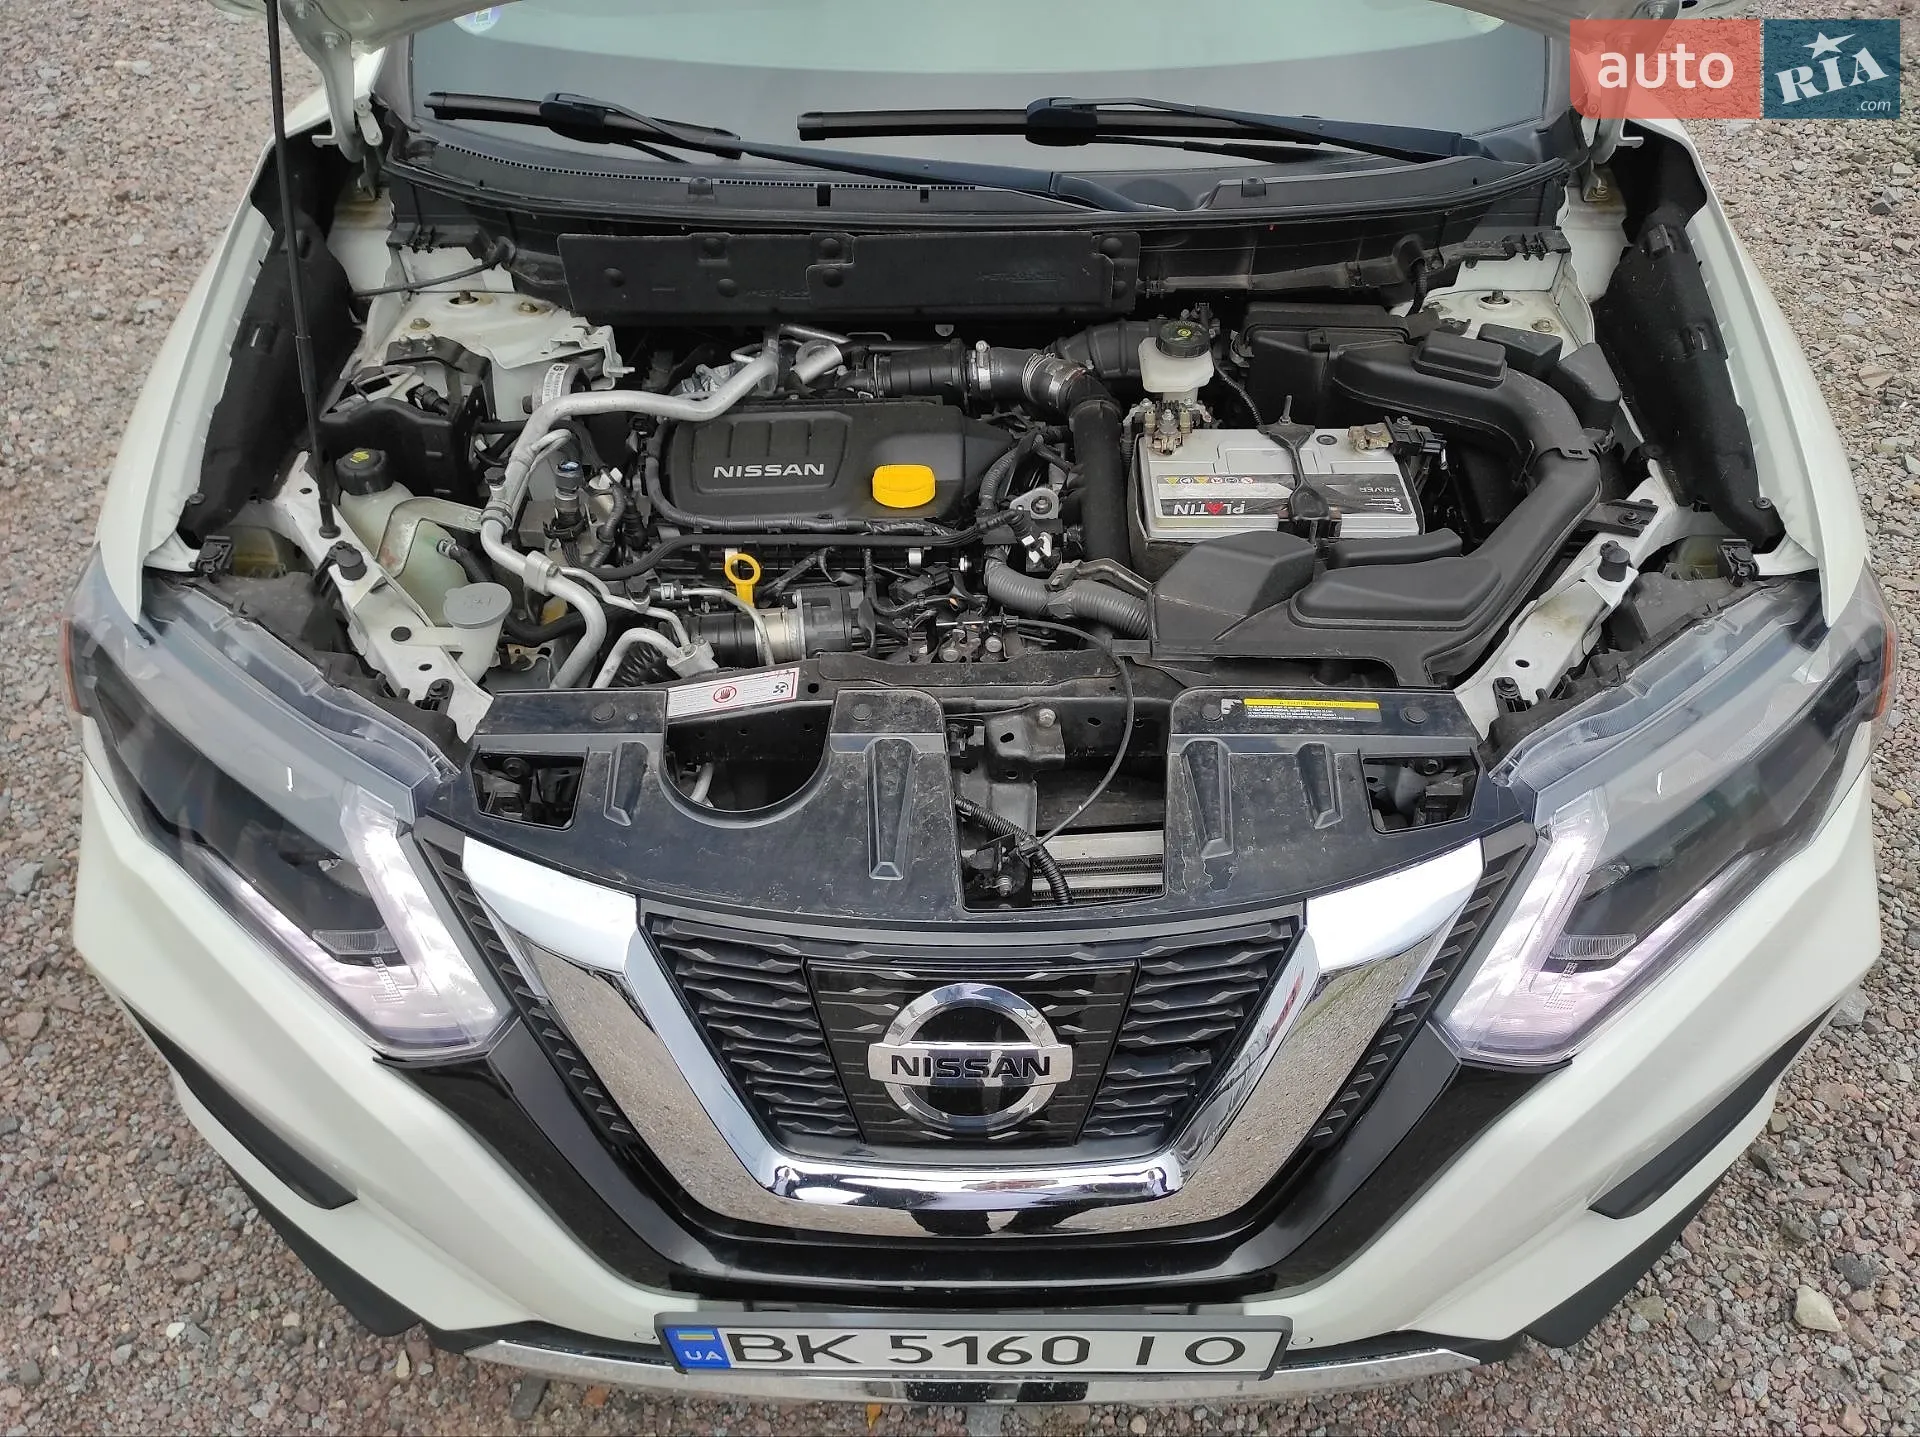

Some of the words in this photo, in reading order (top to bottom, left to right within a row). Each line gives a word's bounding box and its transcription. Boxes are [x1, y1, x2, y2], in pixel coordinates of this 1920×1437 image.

[713, 463, 825, 478] NISSAN
[1359, 486, 1397, 494] SILVER
[1173, 502, 1246, 516] PLATIN
[890, 1054, 1051, 1079] NISSAN
[684, 1350, 724, 1362] UA
[726, 1333, 863, 1365] BK
[887, 1334, 1091, 1366] 5160
